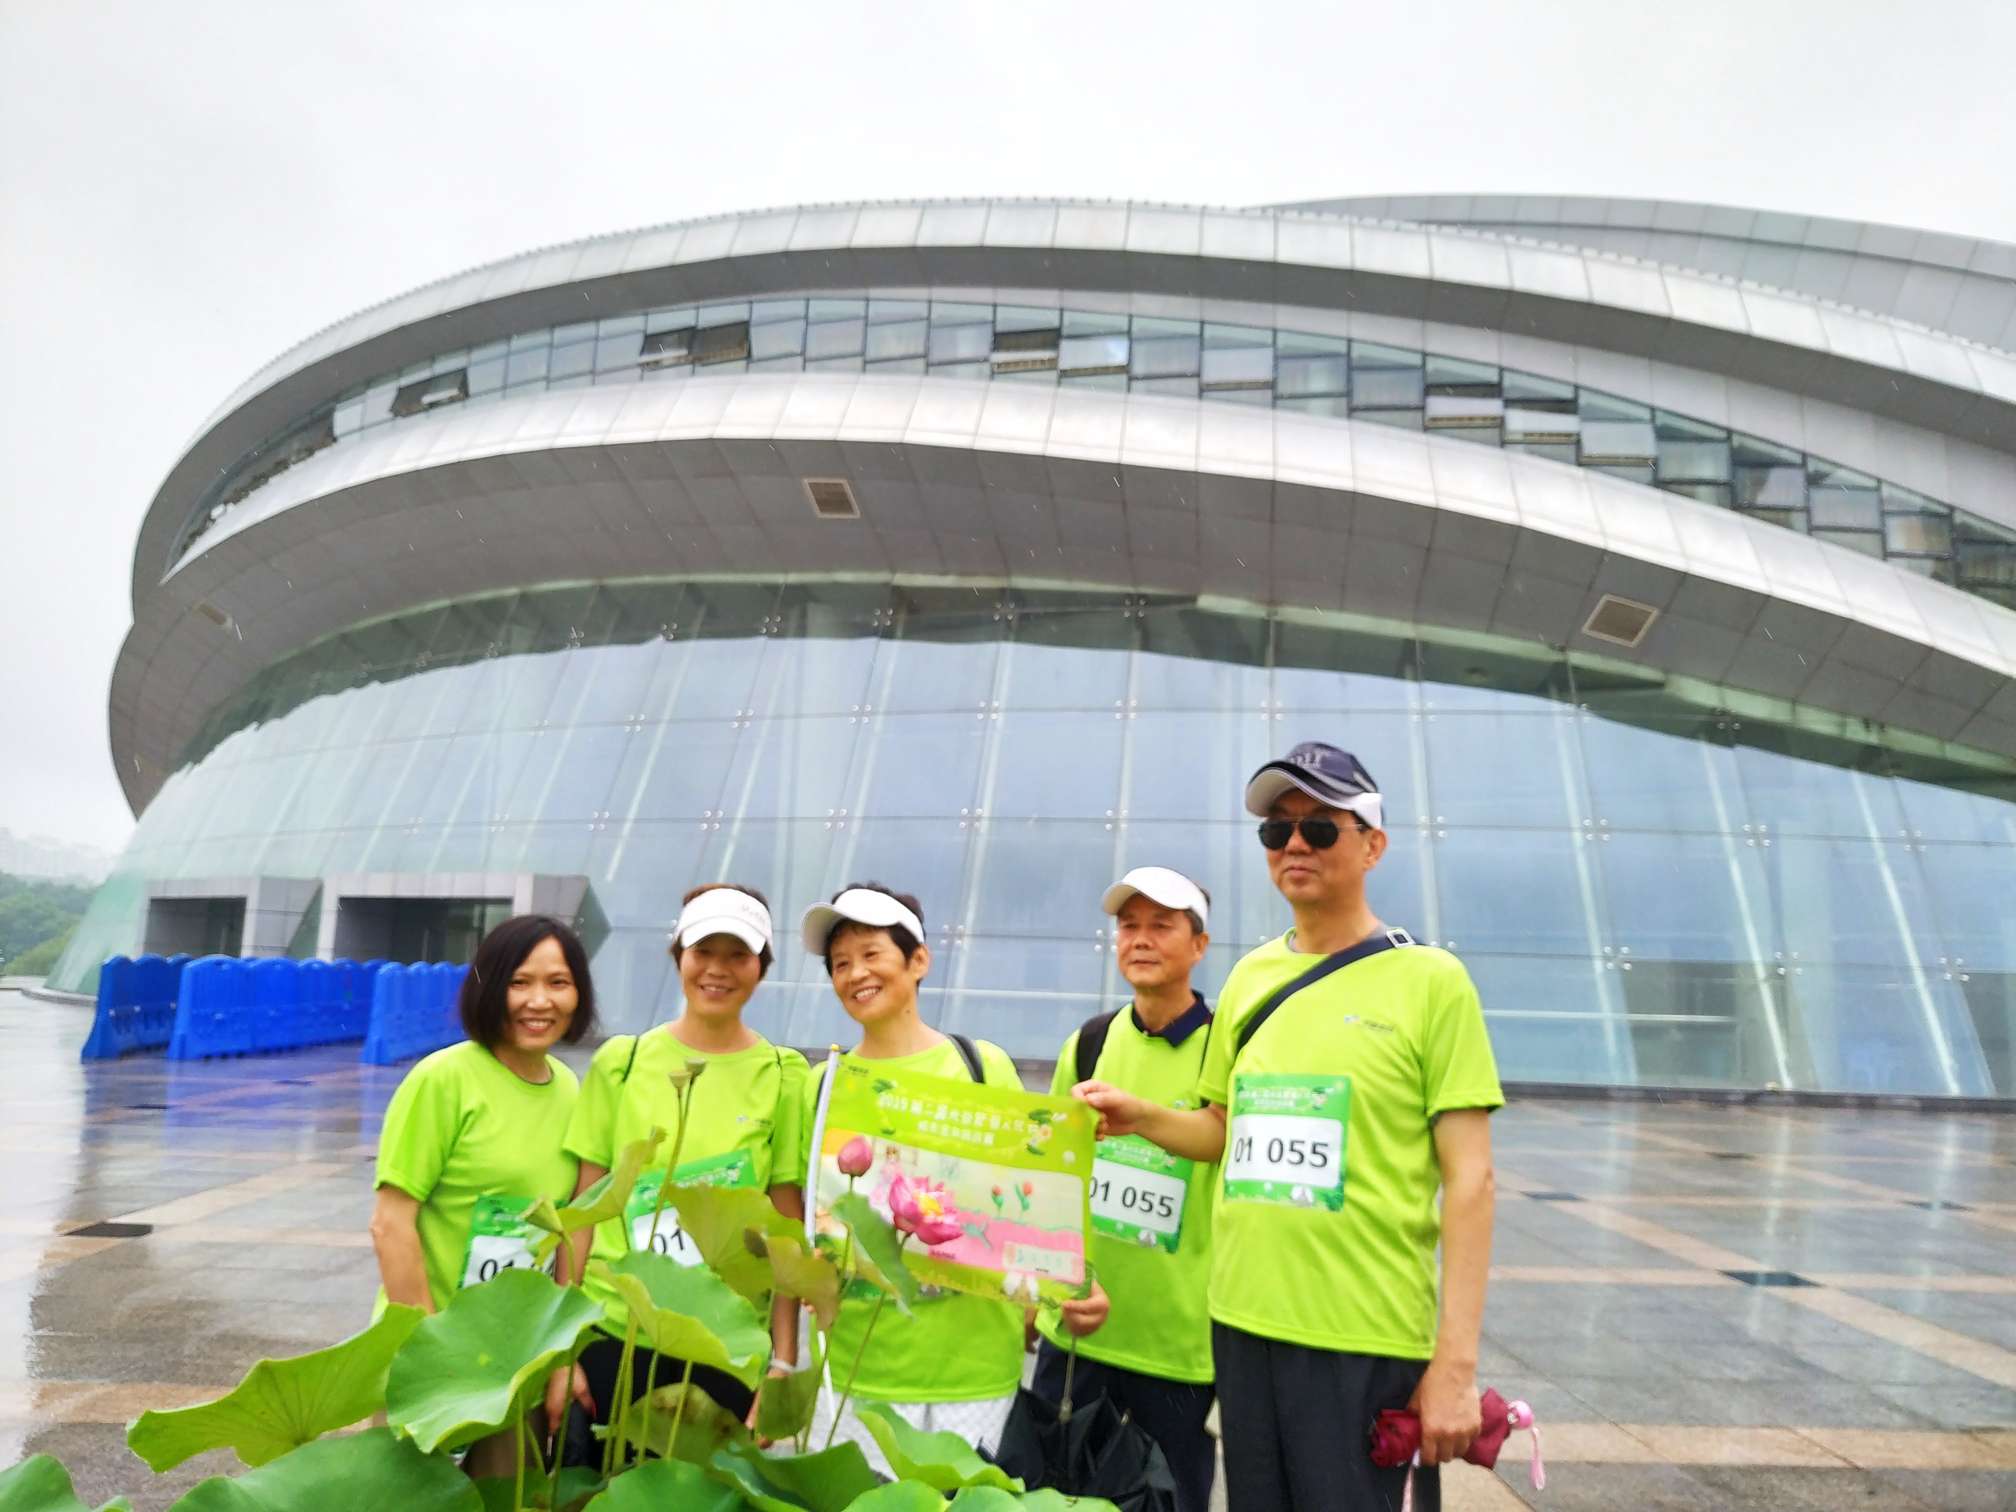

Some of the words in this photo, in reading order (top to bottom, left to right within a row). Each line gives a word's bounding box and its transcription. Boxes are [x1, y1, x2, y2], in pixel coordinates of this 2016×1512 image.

[1234, 1136, 1253, 1162] 01
[1268, 1137, 1329, 1168] 055
[1122, 1186, 1174, 1217] 055
